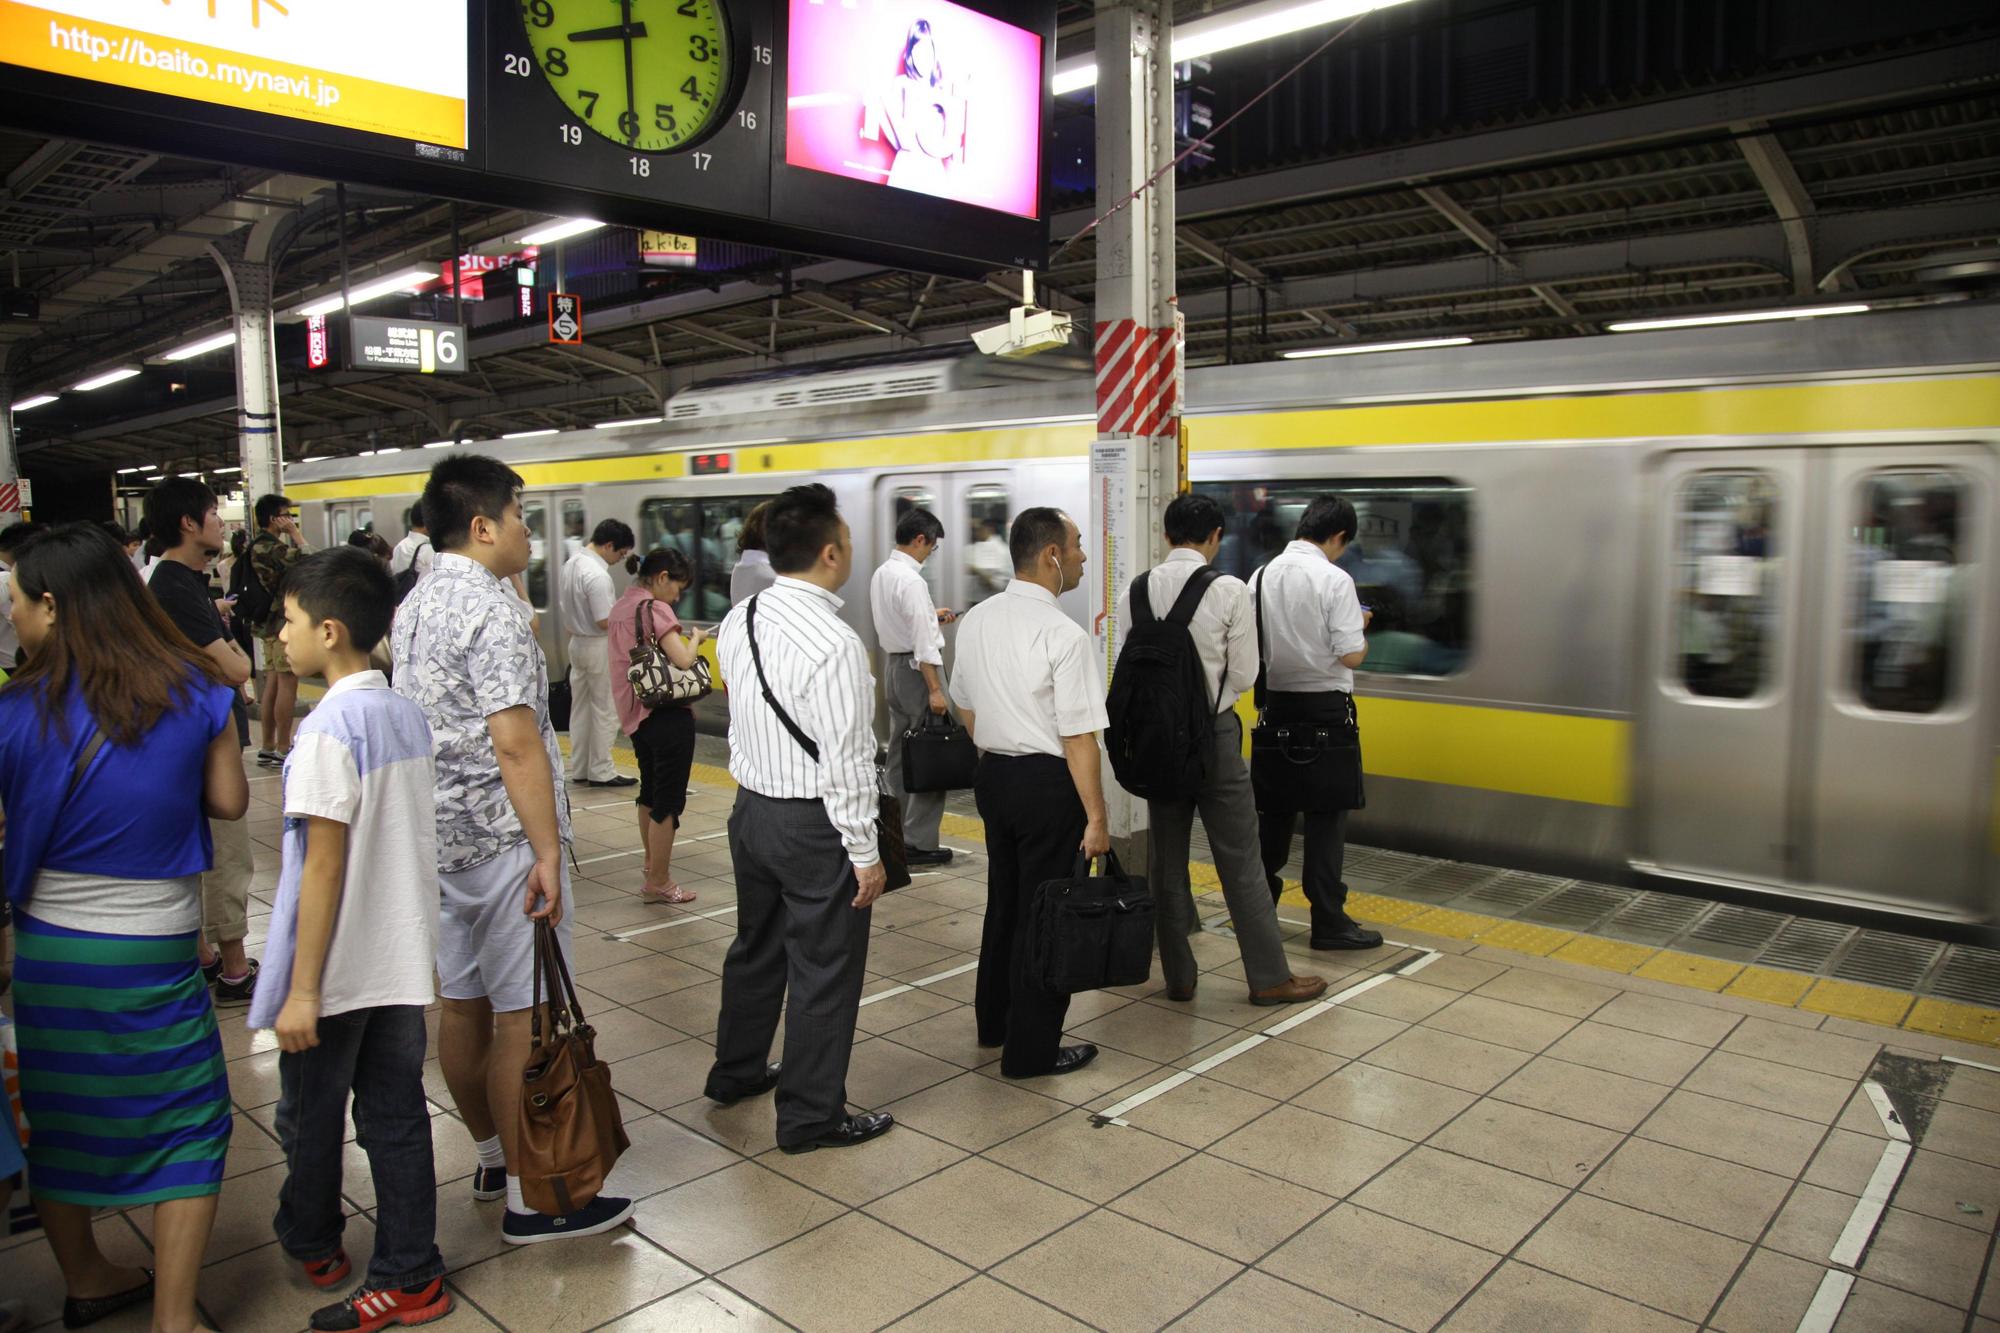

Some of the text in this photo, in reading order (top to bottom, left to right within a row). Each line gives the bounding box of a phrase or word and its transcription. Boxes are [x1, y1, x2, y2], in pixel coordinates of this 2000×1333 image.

[530, 0, 555, 28] 9
[545, 47, 569, 77] 8
[689, 35, 710, 62] 3
[753, 45, 772, 65] 15
[50, 21, 340, 107] http://baito.mynavi.jp
[504, 54, 531, 78] 20
[680, 75, 702, 102] 4
[577, 90, 599, 119] 7
[655, 104, 677, 132] 5
[618, 111, 640, 140] 6
[738, 110, 757, 130] 16
[559, 124, 582, 146] 19
[630, 157, 650, 178] 18
[692, 152, 712, 172] 17
[557, 297, 573, 313] 特
[559, 320, 573, 335] 5
[436, 330, 458, 364] 6
